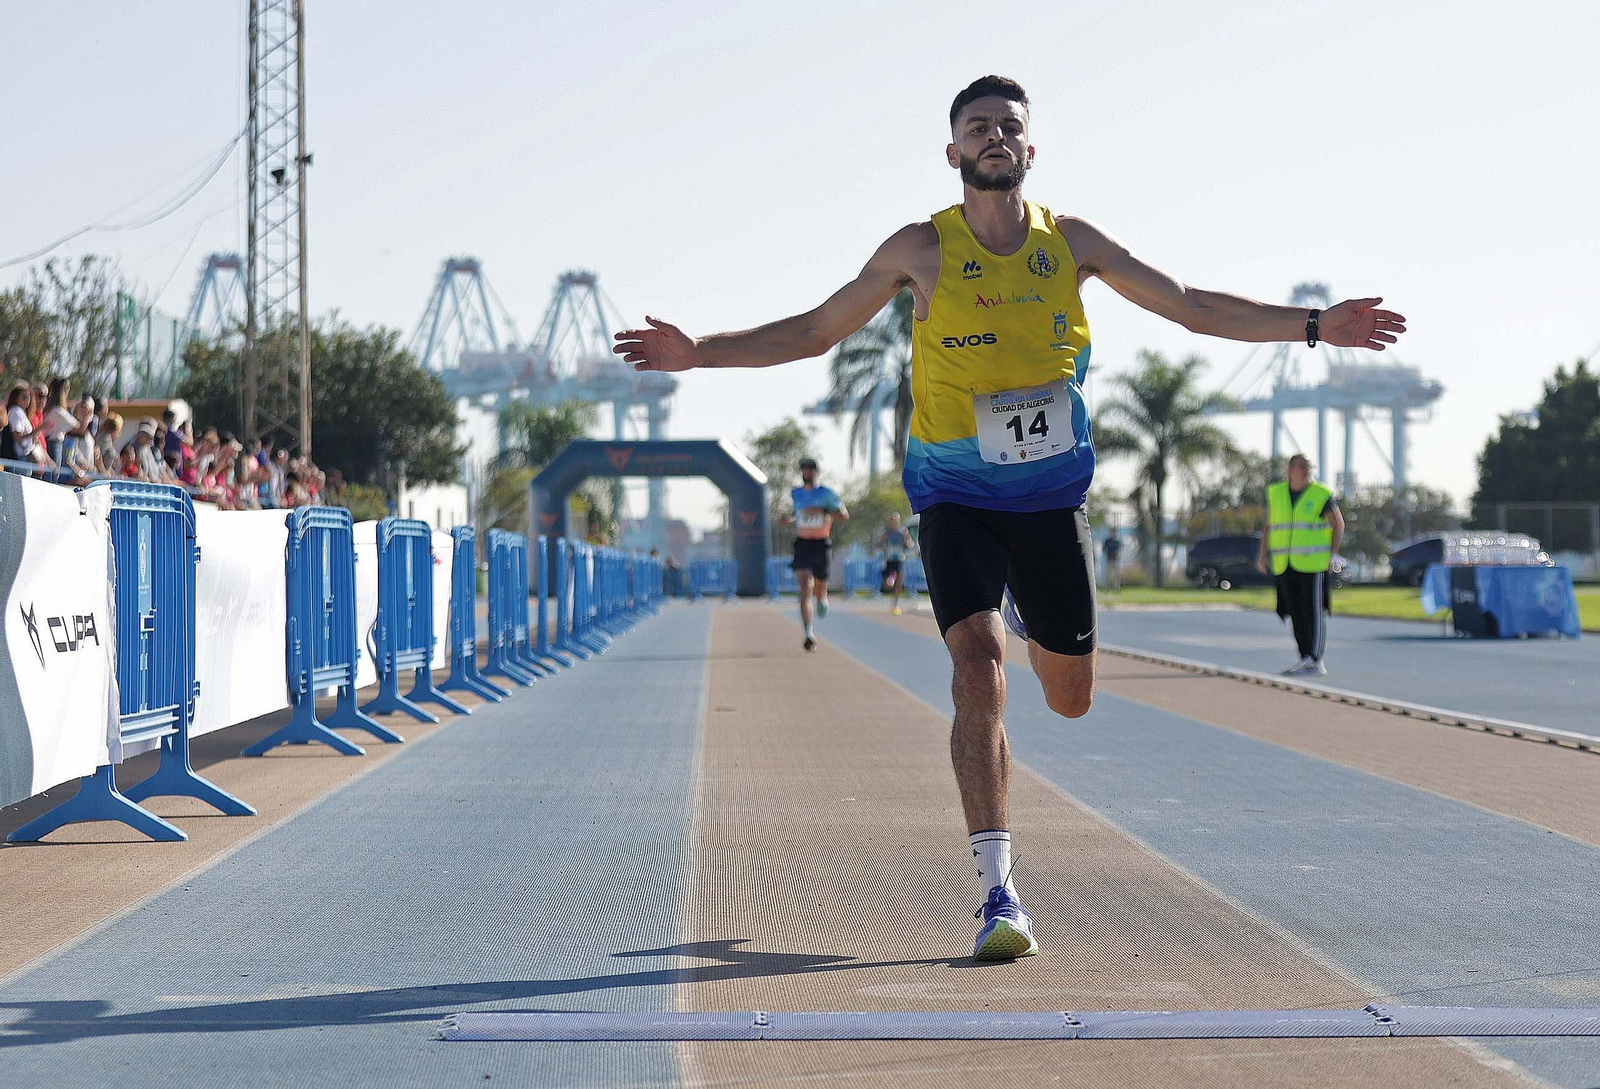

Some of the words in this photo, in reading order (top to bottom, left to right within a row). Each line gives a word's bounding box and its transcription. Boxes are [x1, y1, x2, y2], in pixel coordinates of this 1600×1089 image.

[941, 333, 998, 349] EVOS
[992, 404, 1016, 414] CIUDAD
[1027, 396, 1054, 408] ALGECIRAS
[1006, 410, 1049, 442] 14
